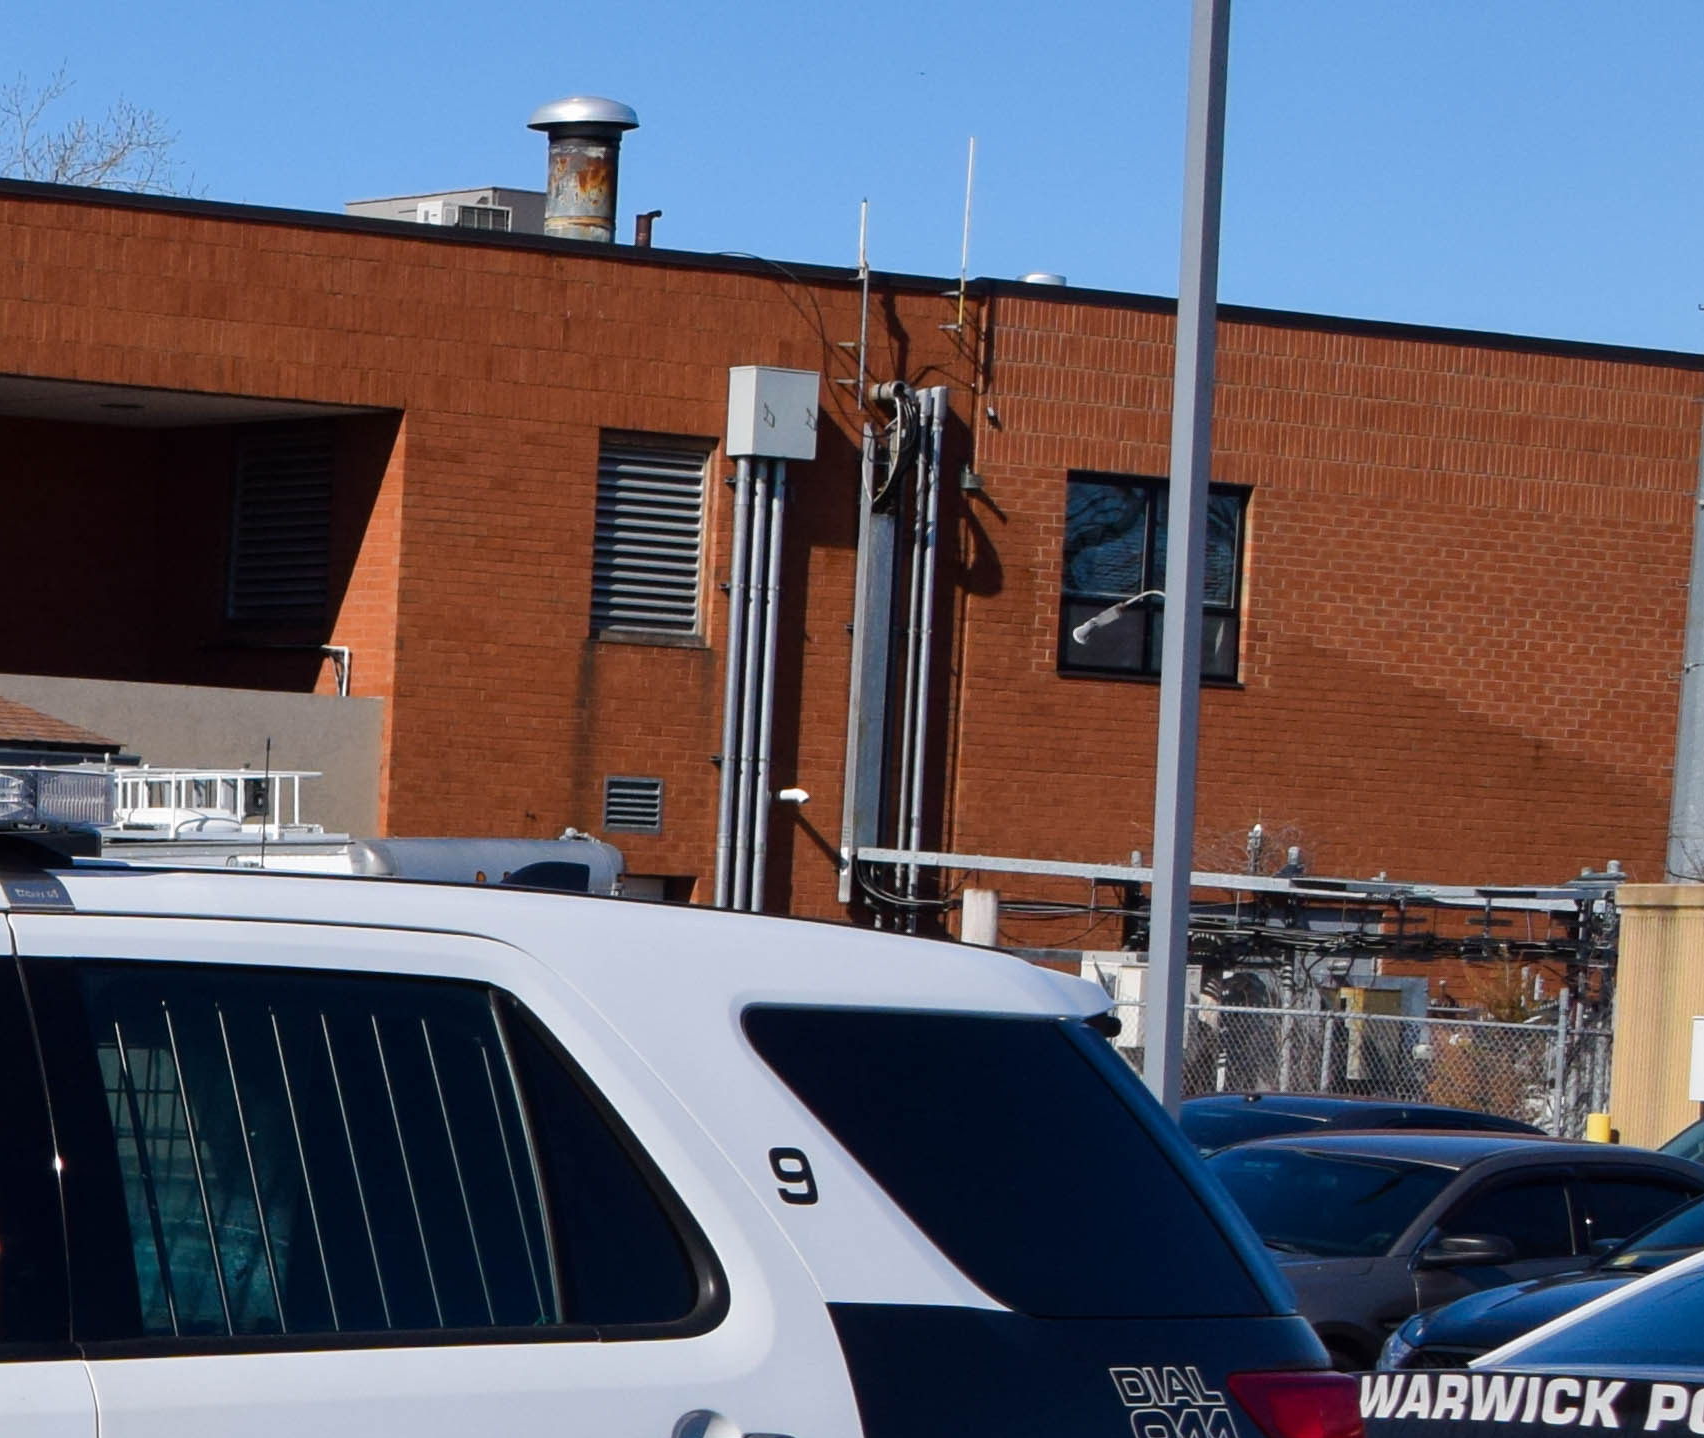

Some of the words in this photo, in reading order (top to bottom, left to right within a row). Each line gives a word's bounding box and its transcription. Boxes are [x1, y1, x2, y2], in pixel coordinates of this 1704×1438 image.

[768, 1146, 819, 1206] 9
[1108, 1366, 1227, 1407] DIAL
[1359, 1373, 1628, 1429] WARWICK
